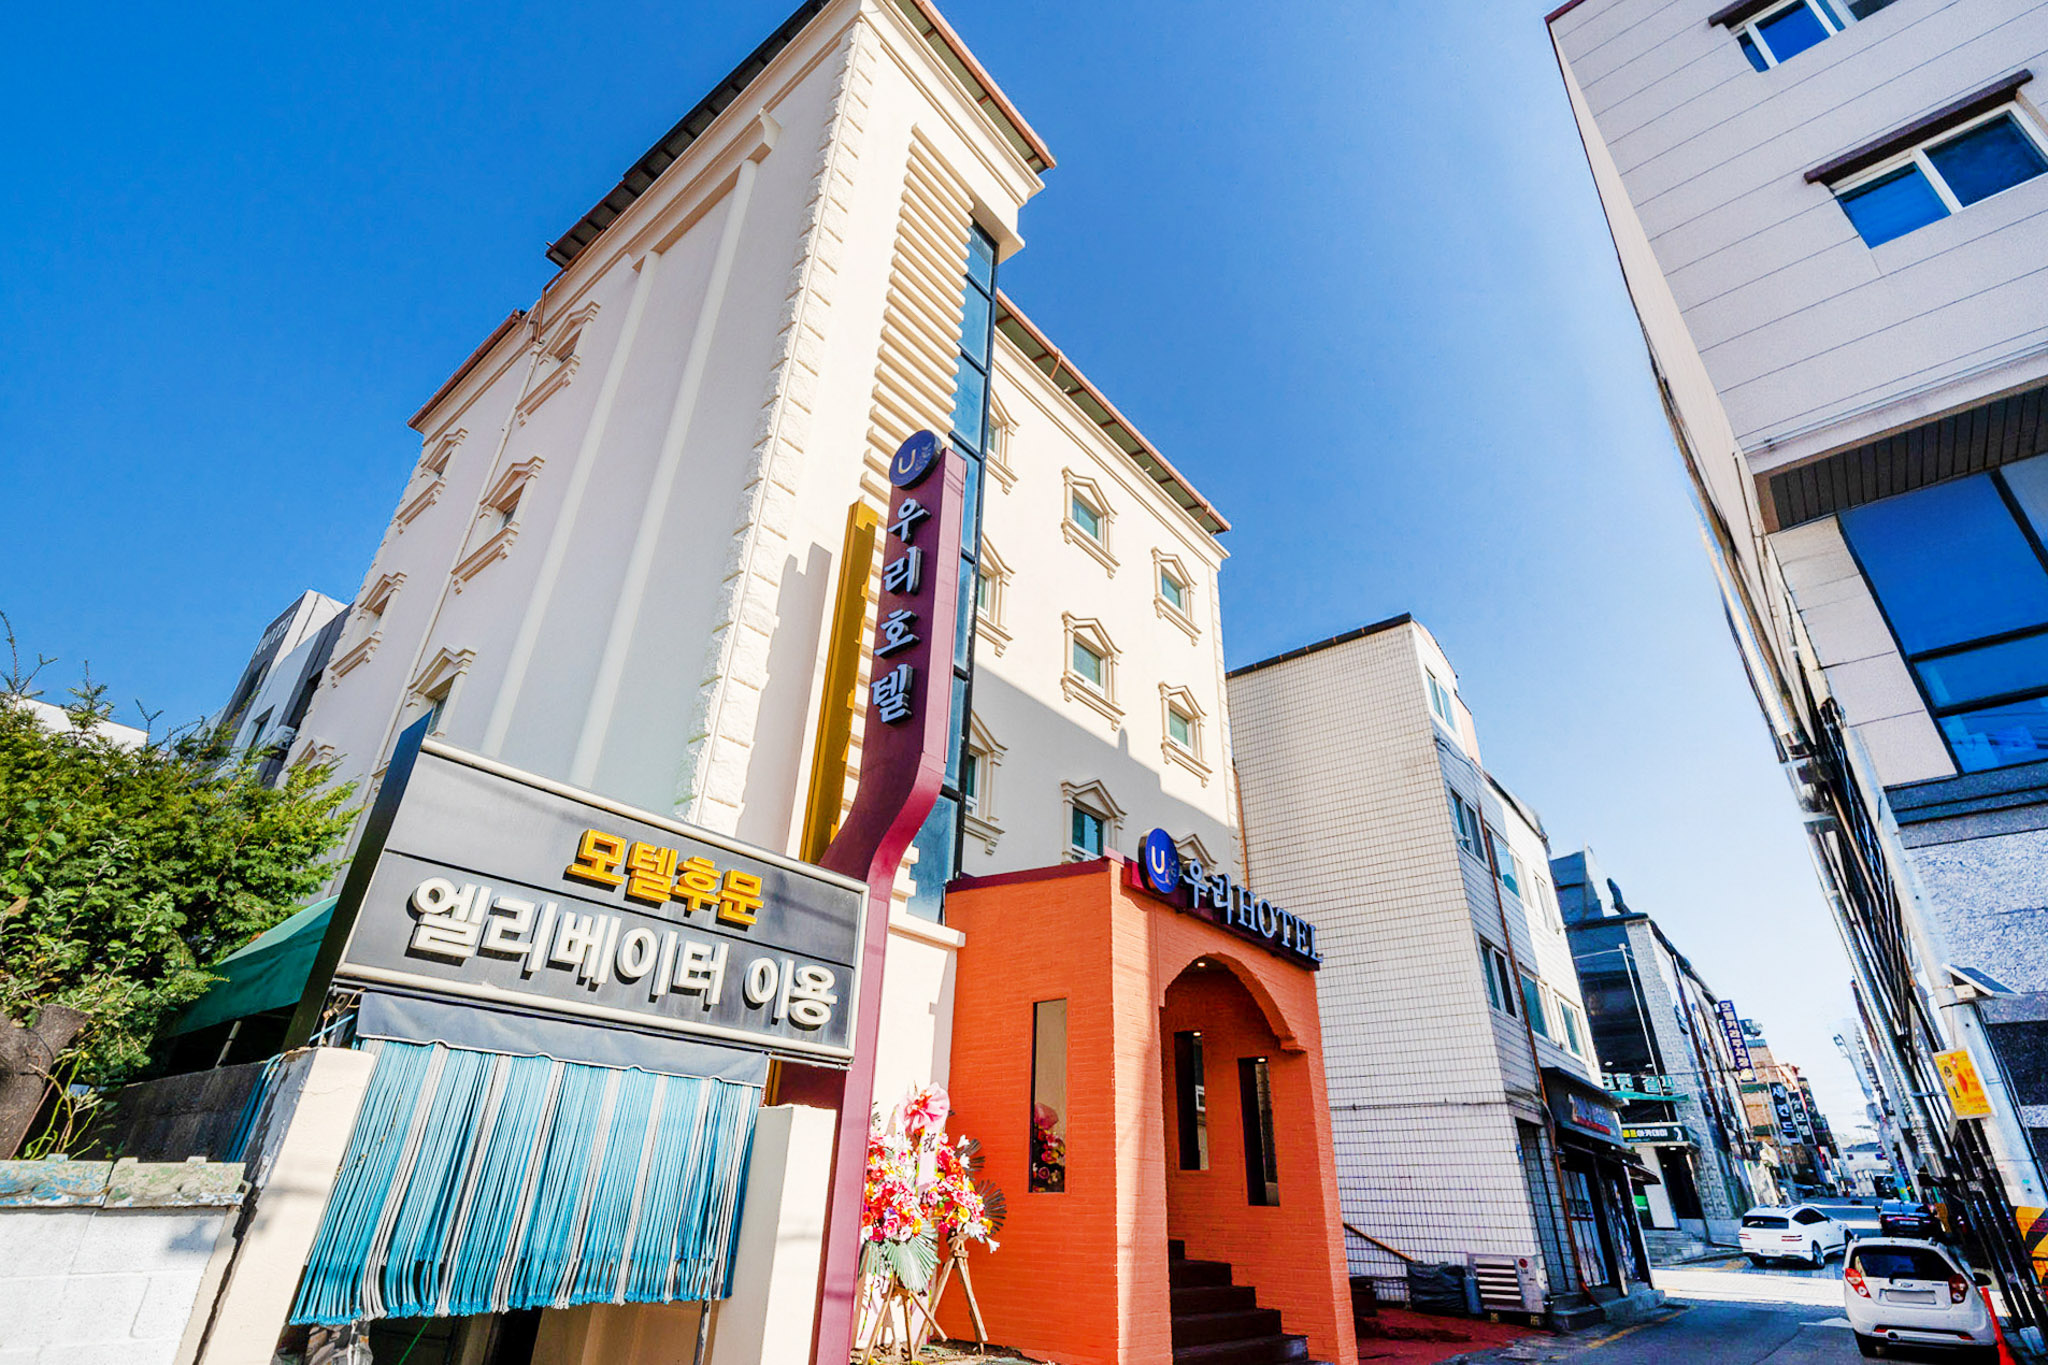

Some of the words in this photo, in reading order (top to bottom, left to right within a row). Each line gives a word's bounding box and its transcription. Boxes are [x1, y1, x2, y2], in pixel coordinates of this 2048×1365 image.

[871, 498, 931, 724] 우리호텔
[567, 828, 765, 926] 모텔후문
[1238, 885, 1324, 963] HOTEL
[411, 877, 730, 1005] 엘리베이터
[743, 957, 838, 1027] 이용
